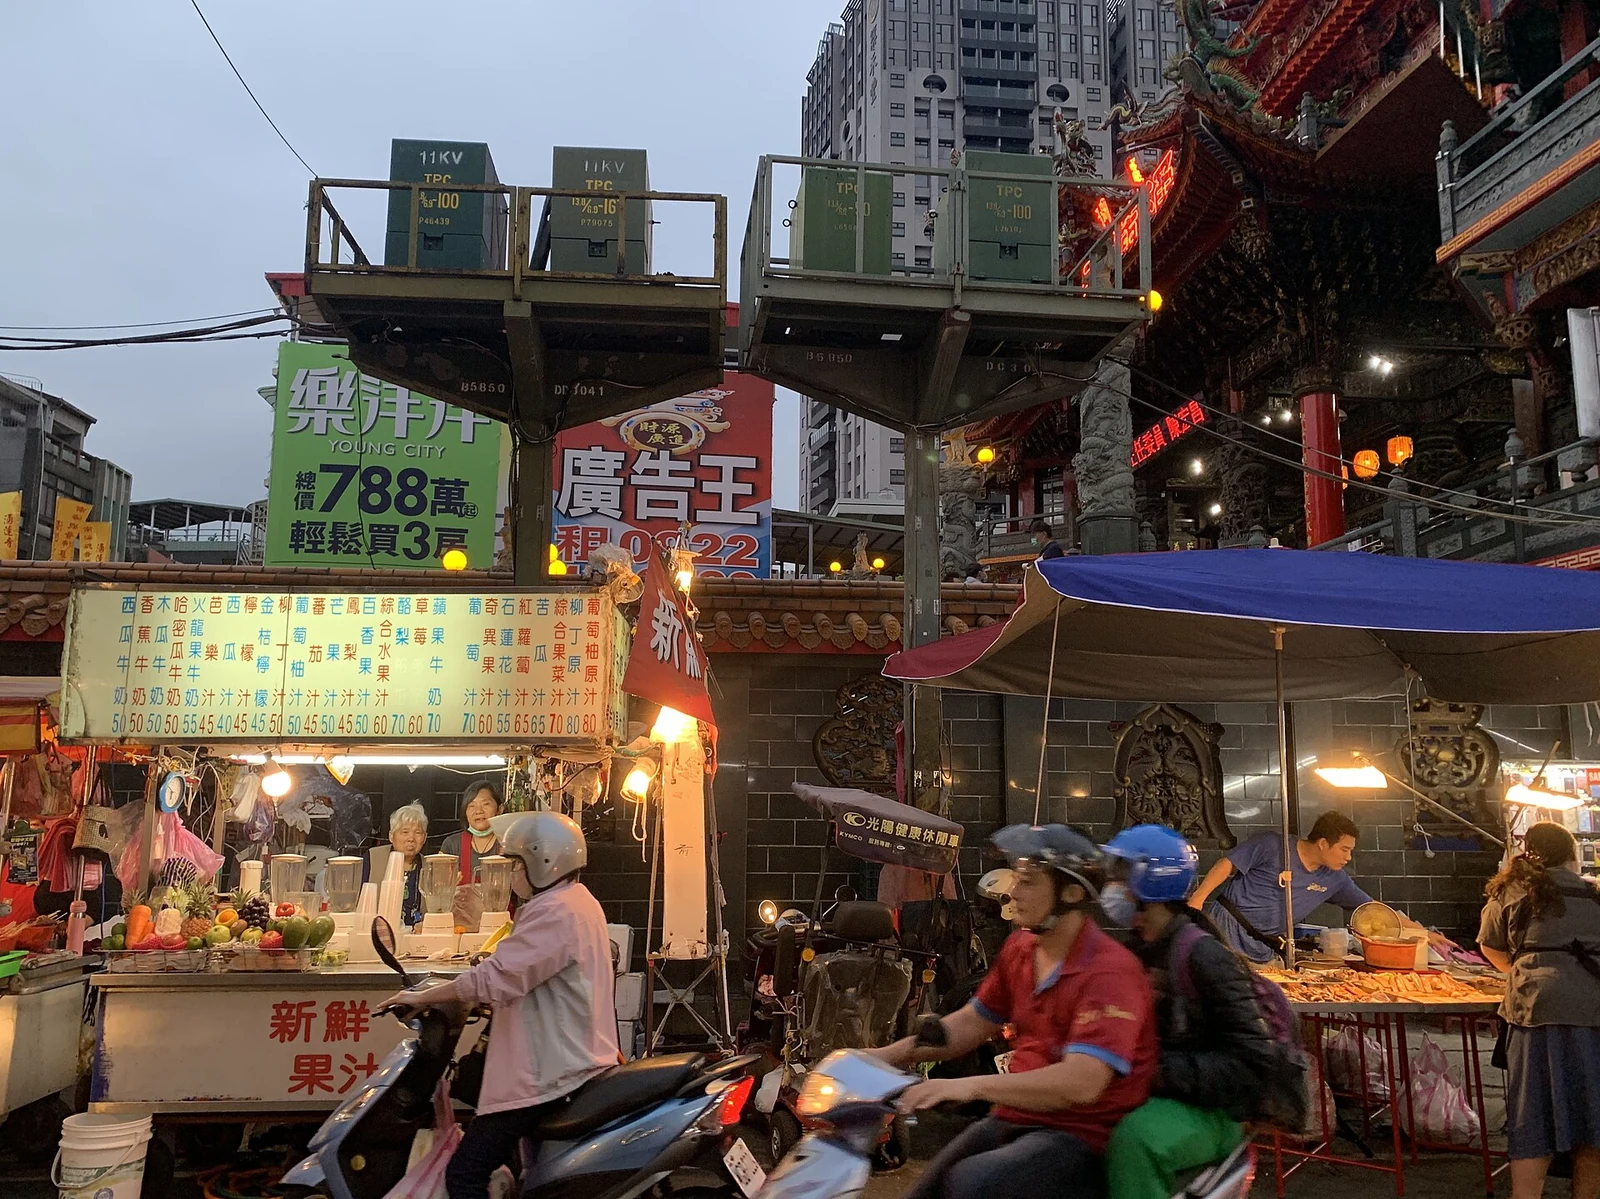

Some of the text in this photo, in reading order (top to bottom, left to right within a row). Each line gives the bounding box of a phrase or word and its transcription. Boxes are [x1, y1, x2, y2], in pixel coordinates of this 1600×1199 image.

[420, 150, 463, 165] 11KV
[584, 160, 625, 173] 11KV
[424, 173, 452, 184] TPC
[585, 180, 613, 191] TPC
[996, 185, 1023, 198] TPC
[461, 381, 506, 393] B5850
[328, 439, 447, 459] YOUNG CITY
[555, 446, 759, 525] 廣告王
[112, 713, 126, 733] 50
[130, 713, 144, 733] 50
[146, 713, 162, 734] 50
[164, 714, 179, 734] 50
[183, 713, 197, 734] 55
[199, 714, 214, 734] 45
[217, 714, 232, 734] 40
[234, 713, 248, 733] 45
[251, 713, 266, 733] 45
[269, 713, 283, 734] 50
[287, 715, 301, 735] 50
[304, 714, 318, 734] 45
[321, 714, 335, 734] 50
[338, 714, 353, 734] 45
[355, 714, 369, 734] 50
[373, 714, 388, 735] 60
[391, 714, 405, 735] 70
[408, 715, 423, 735] 60
[427, 713, 441, 733] 70
[462, 713, 475, 733] 70
[478, 714, 493, 734] 60
[497, 713, 511, 733] 55
[514, 713, 529, 733] 65
[531, 714, 545, 735] 65
[550, 713, 563, 733] 70
[567, 714, 580, 734] 80
[583, 713, 597, 733] 80
[839, 830, 863, 842] KYMCO
[269, 999, 370, 1043] 新鮮
[287, 1052, 380, 1095] 果汁
